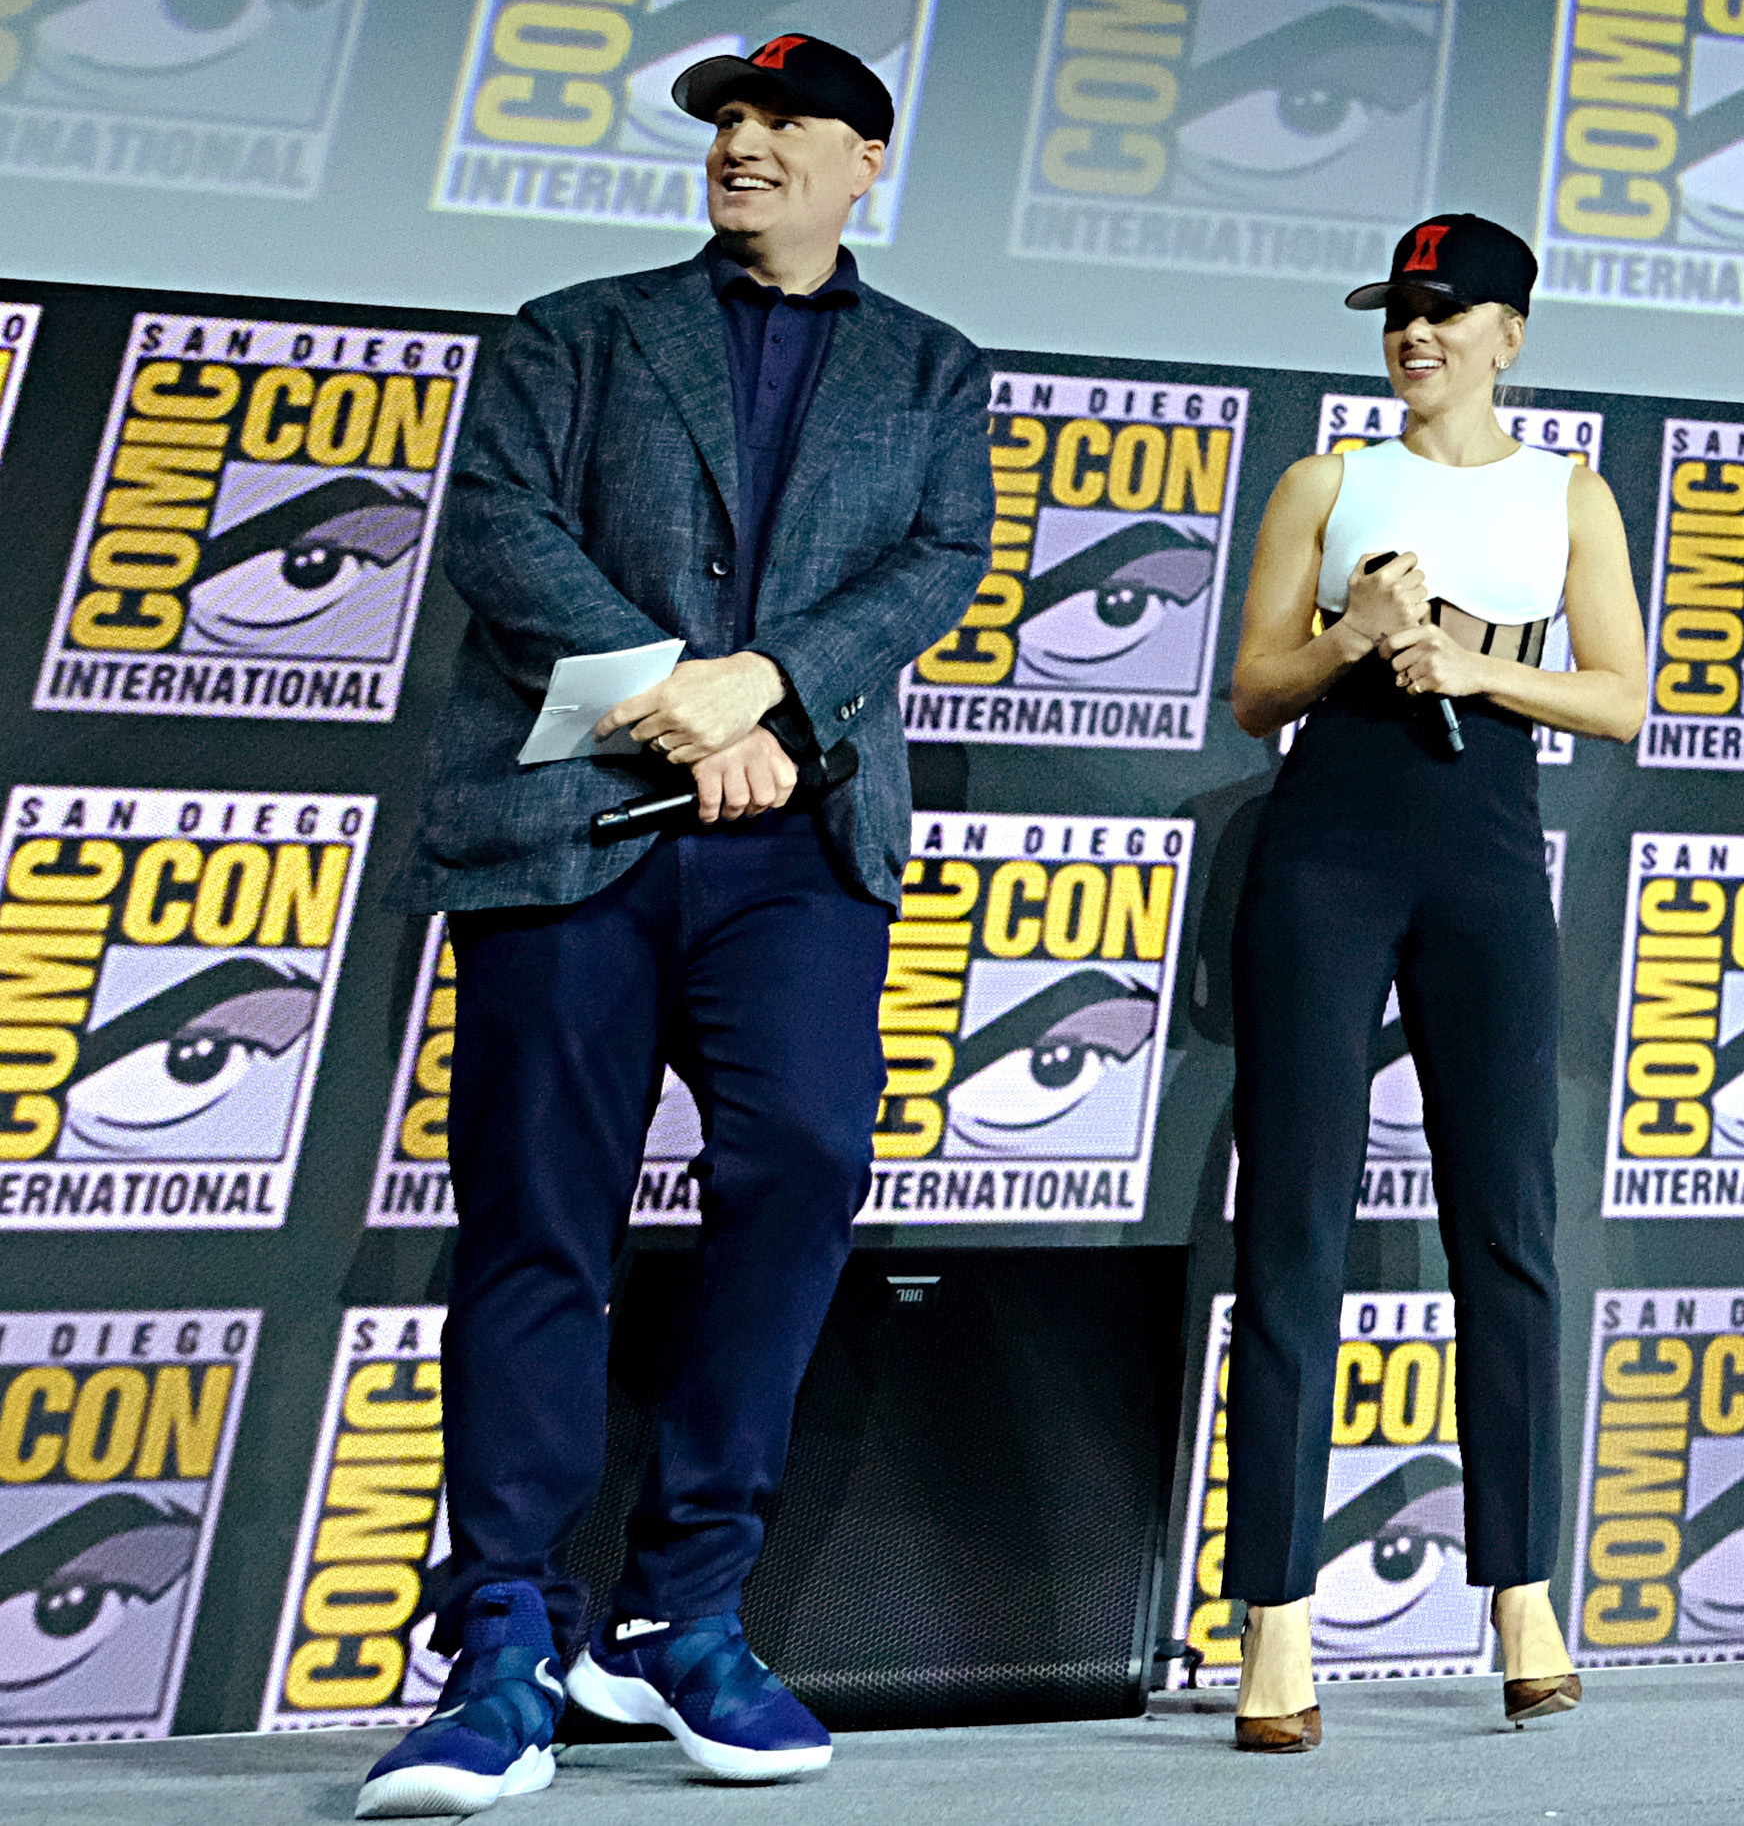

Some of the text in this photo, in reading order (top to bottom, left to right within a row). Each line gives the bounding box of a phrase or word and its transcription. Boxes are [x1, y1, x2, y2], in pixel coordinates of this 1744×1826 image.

[141, 322, 465, 373] SAN DIEGO
[238, 366, 455, 471] CON
[1087, 386, 1240, 423] DIEGO
[1049, 418, 1233, 515] CON
[69, 360, 244, 652] COMIC
[49, 658, 384, 711] INTERNATIONAL
[17, 796, 364, 837] SAN DIEGO
[1023, 824, 1184, 859] DIEGO
[121, 838, 352, 948] CON
[1640, 841, 1729, 872] SAN
[982, 860, 1176, 961] CON
[1620, 877, 1729, 1159] COMIC
[1601, 1295, 1695, 1331] SAN
[1582, 1335, 1695, 1647] COMIC
